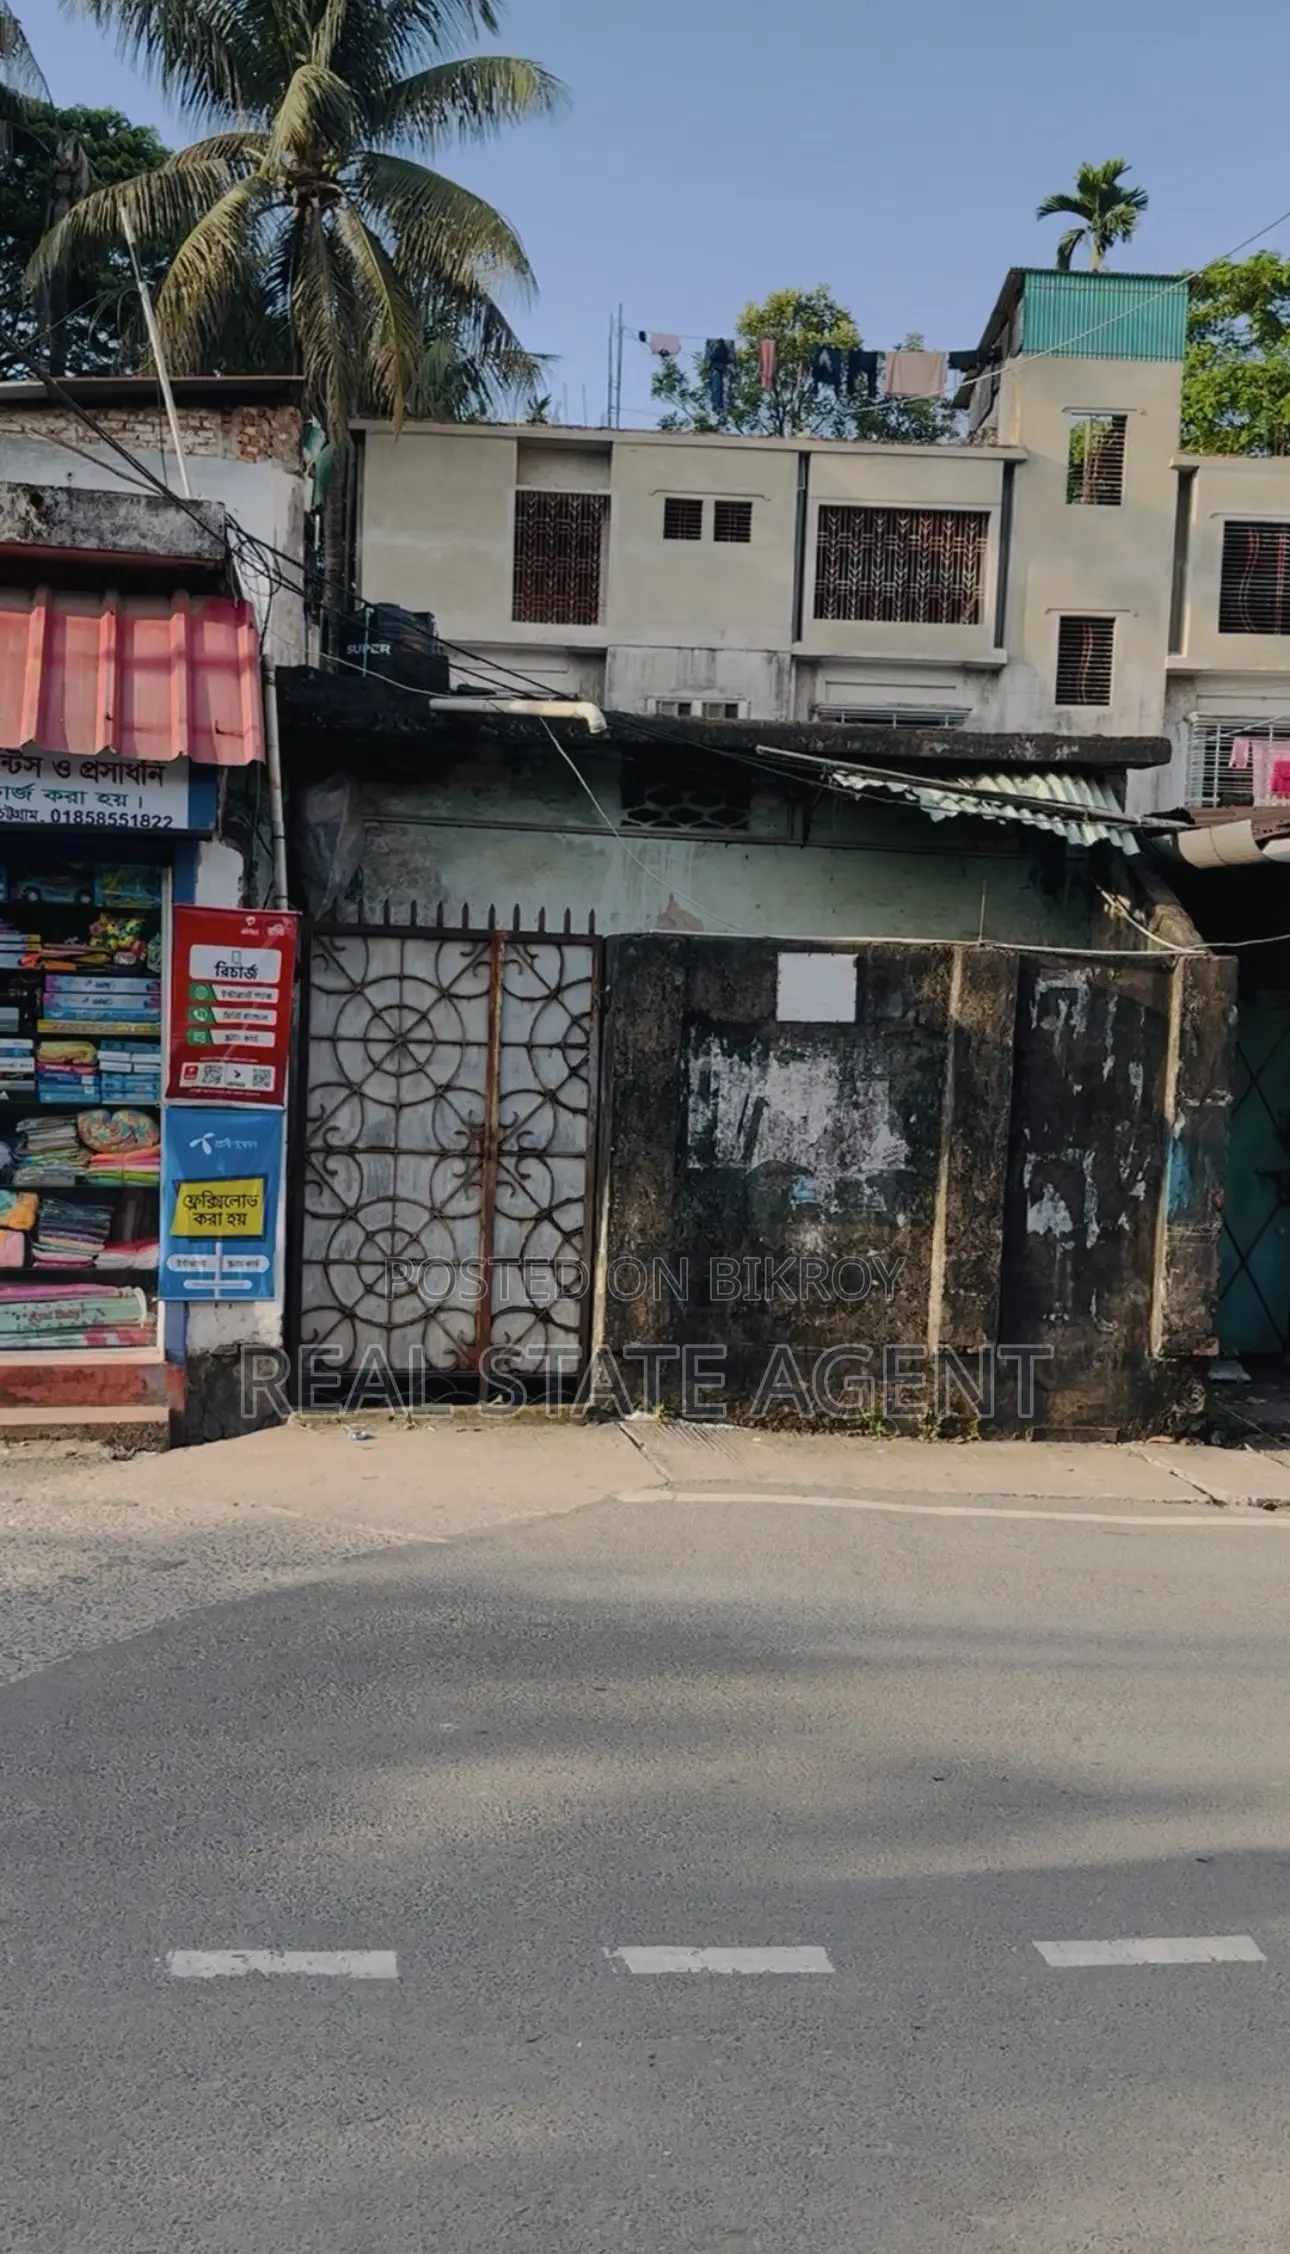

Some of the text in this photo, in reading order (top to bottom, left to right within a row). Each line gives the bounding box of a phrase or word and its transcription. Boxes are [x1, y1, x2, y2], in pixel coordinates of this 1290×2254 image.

[52, 760, 71, 779] ও
[41, 788, 88, 806] করা
[95, 791, 131, 808] হয়
[51, 808, 173, 829] 01858551822
[214, 960, 259, 980] রিচার্জ
[193, 1212, 248, 1227] করা হয়
